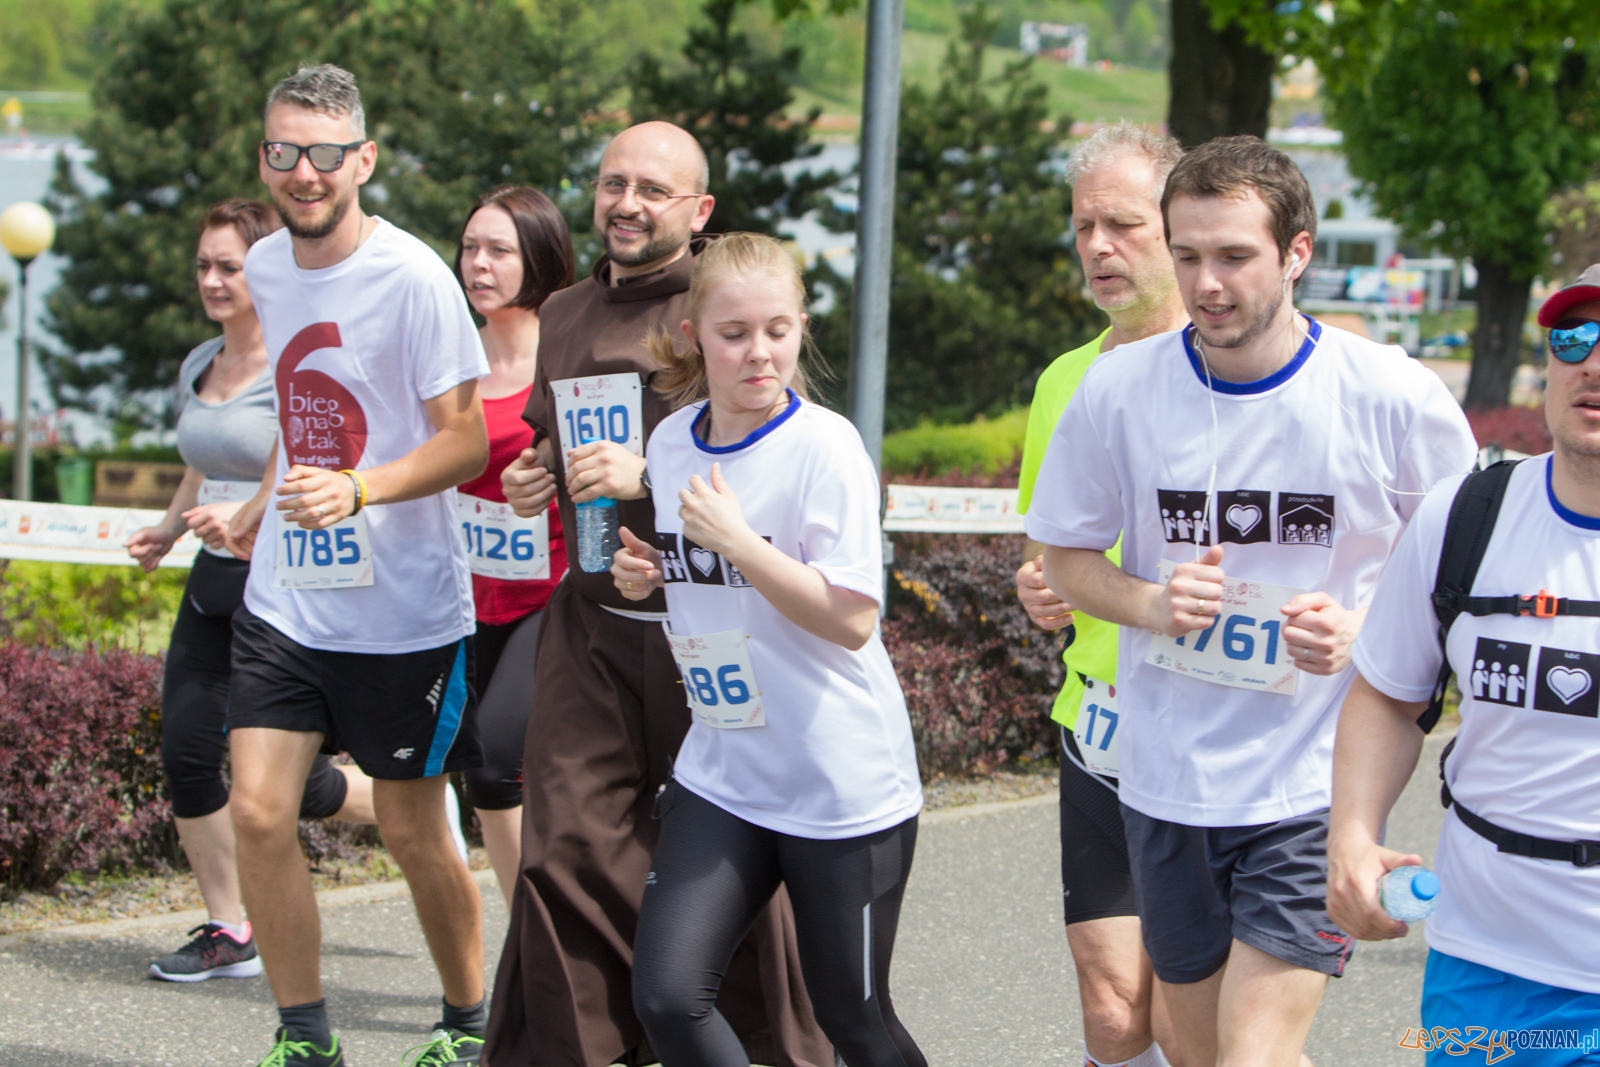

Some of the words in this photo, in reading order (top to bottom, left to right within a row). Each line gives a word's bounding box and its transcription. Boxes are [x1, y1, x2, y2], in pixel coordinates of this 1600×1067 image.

[289, 382, 345, 428] bieg
[305, 416, 329, 430] na
[306, 430, 342, 449] tak
[307, 455, 316, 465] of
[317, 455, 341, 467] Spirit
[283, 527, 361, 567] 1785
[462, 521, 534, 561] 1126
[393, 748, 415, 759] 4F
